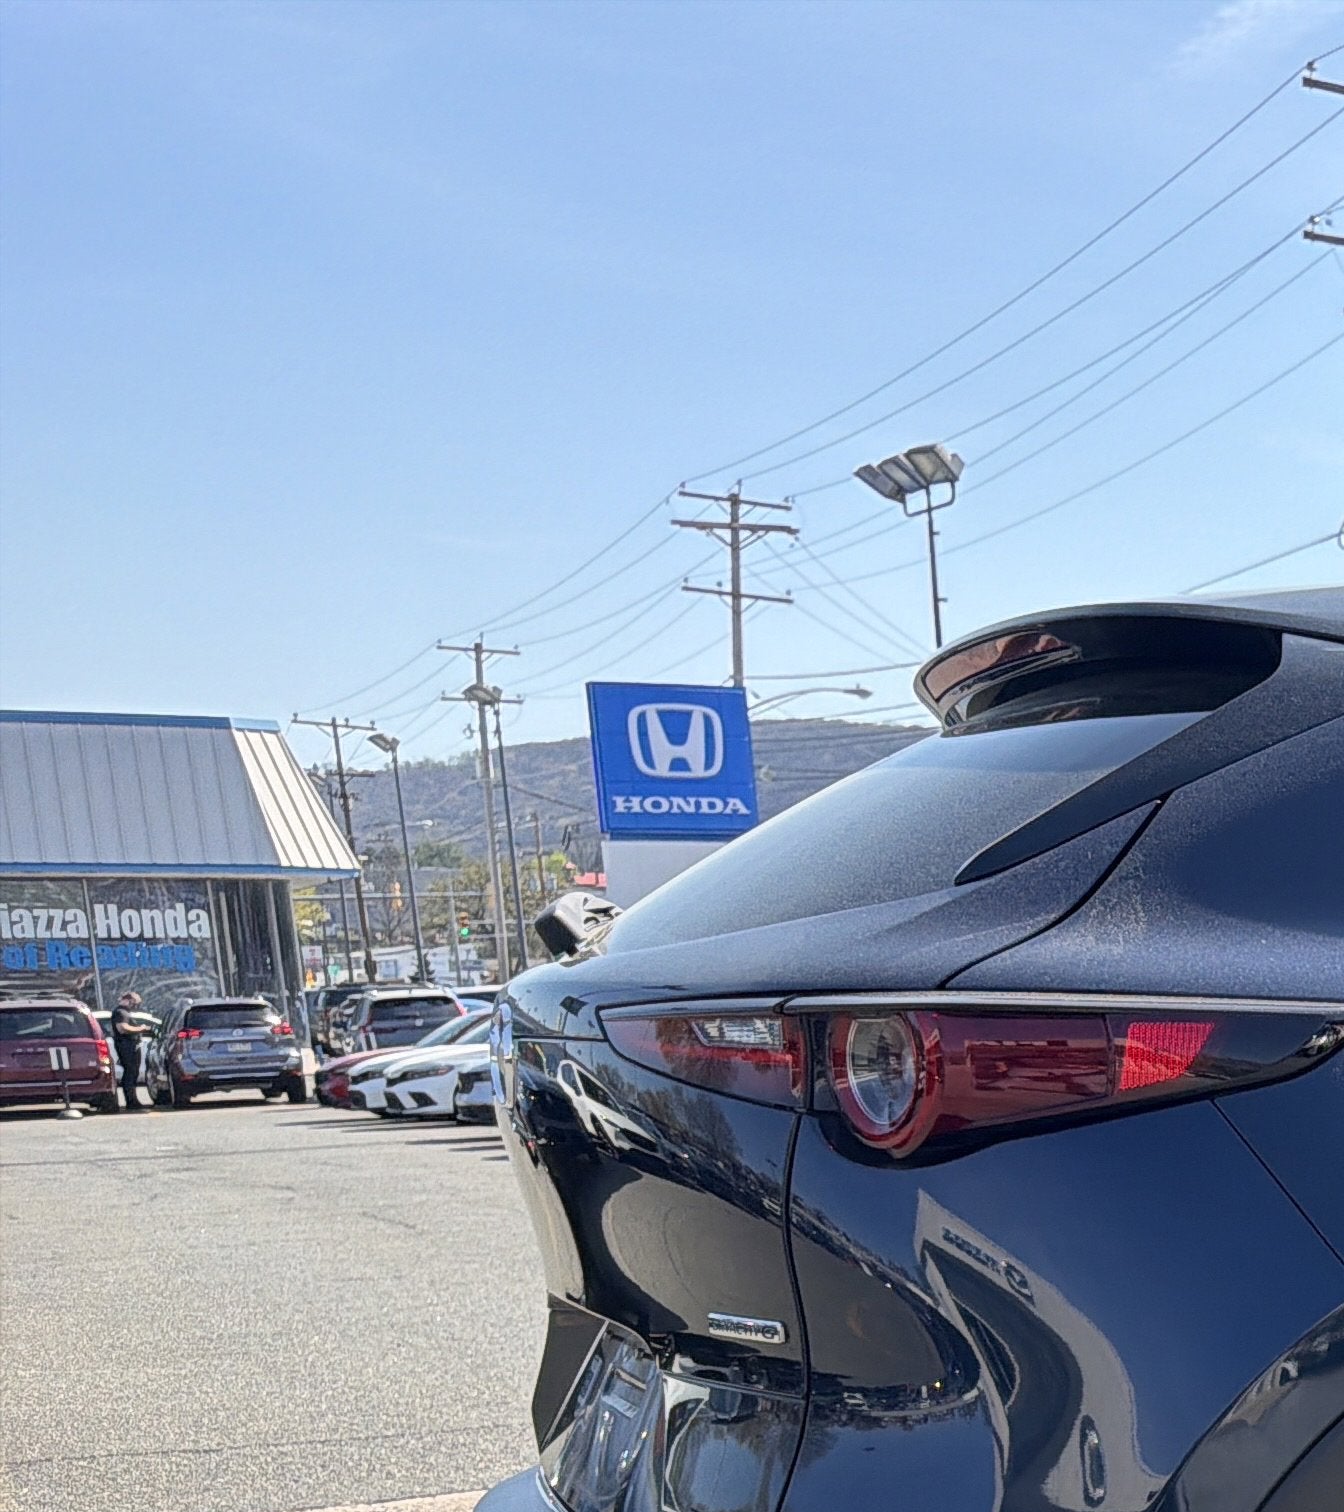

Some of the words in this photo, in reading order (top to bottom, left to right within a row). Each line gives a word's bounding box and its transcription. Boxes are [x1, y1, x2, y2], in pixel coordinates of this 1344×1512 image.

[612, 795, 750, 815] HONDA
[0, 903, 90, 939] iazza
[93, 903, 212, 938] Honda
[3, 942, 39, 969] of
